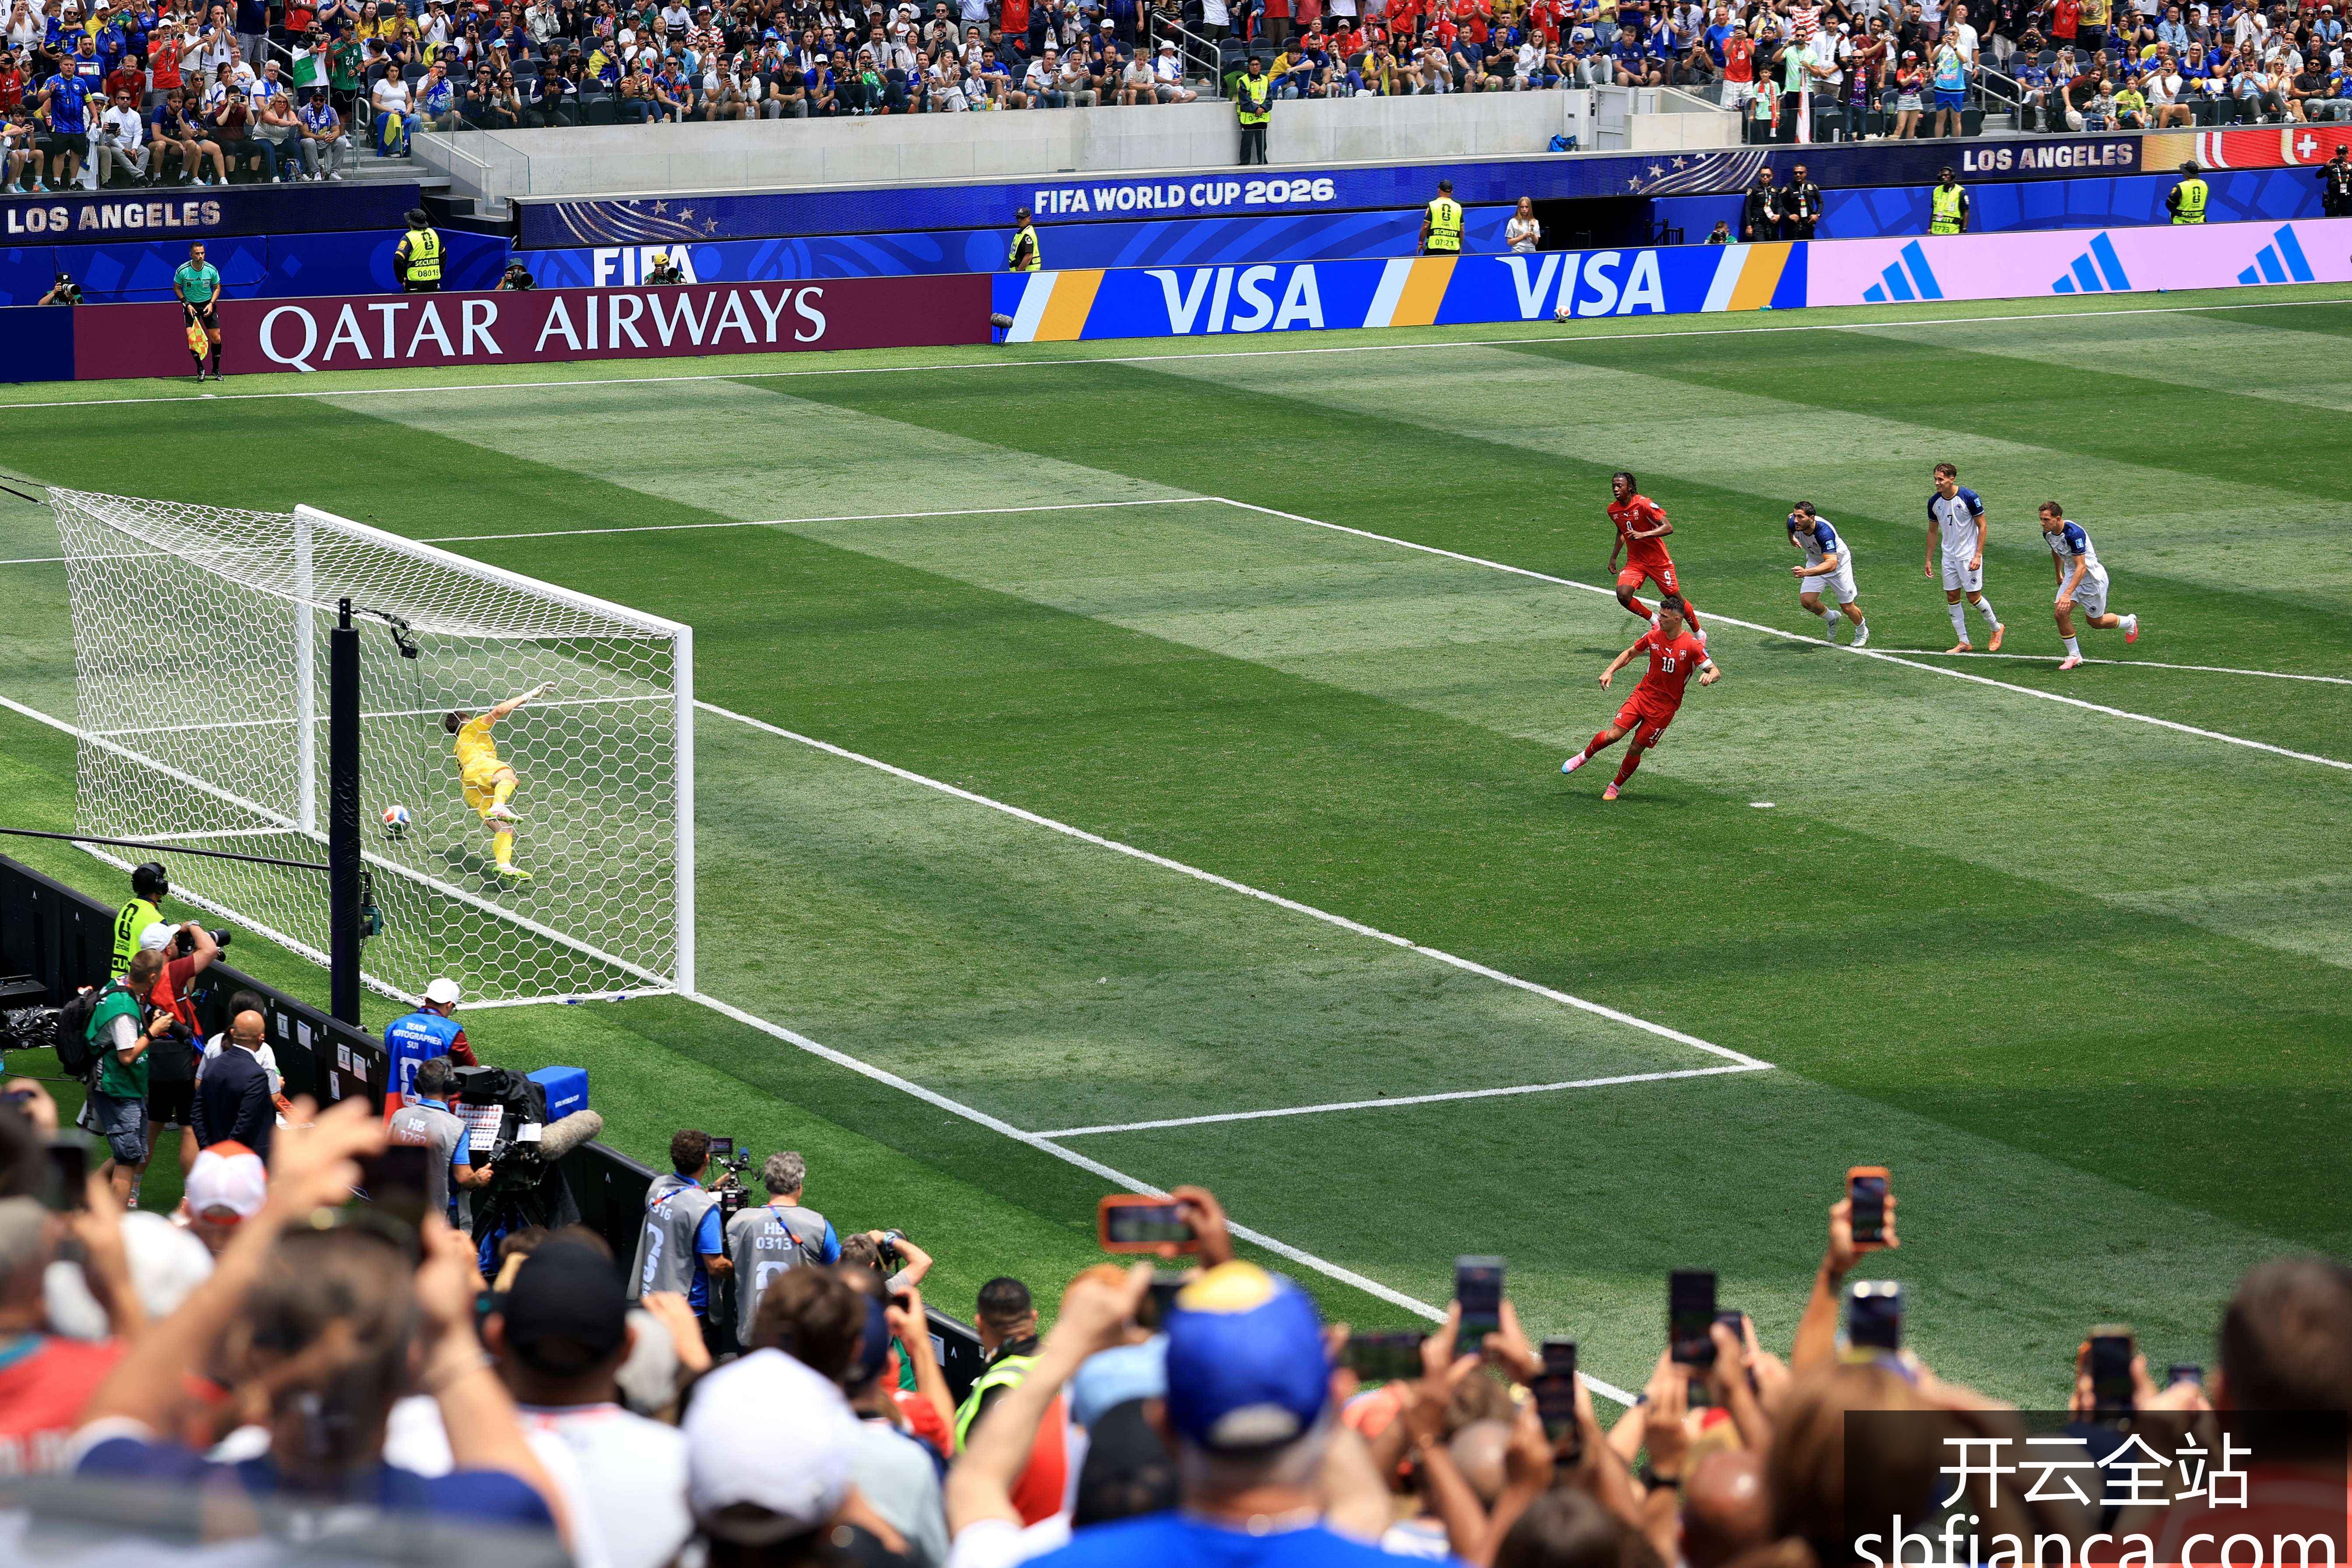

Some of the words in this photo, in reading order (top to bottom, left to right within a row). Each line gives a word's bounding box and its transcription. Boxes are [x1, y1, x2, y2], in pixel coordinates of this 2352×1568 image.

[1963, 149, 2013, 172] LOS
[2019, 144, 2133, 169] ANGELES
[1035, 189, 1090, 215] FIFA
[1094, 185, 1186, 211] WORLD
[1190, 182, 1241, 207] CUP
[1245, 178, 1335, 205] 2026
[8, 207, 69, 234] LOS
[79, 201, 221, 230] ANGELES
[418, 268, 439, 277] 08019
[593, 245, 697, 285] FIFA
[1495, 250, 1665, 319] VISA
[1144, 264, 1325, 335] VISA
[259, 300, 503, 372] QATAR
[534, 286, 827, 352] AIRWAYS
[1947, 514, 1953, 526] 7
[1664, 570, 1672, 585] 9
[1662, 656, 1676, 673] 10
[406, 1022, 427, 1032] TEAM
[406, 1040, 419, 1050] SUI
[408, 1117, 426, 1132] HB
[764, 1222, 786, 1236] HB
[755, 1237, 792, 1251] 0313
